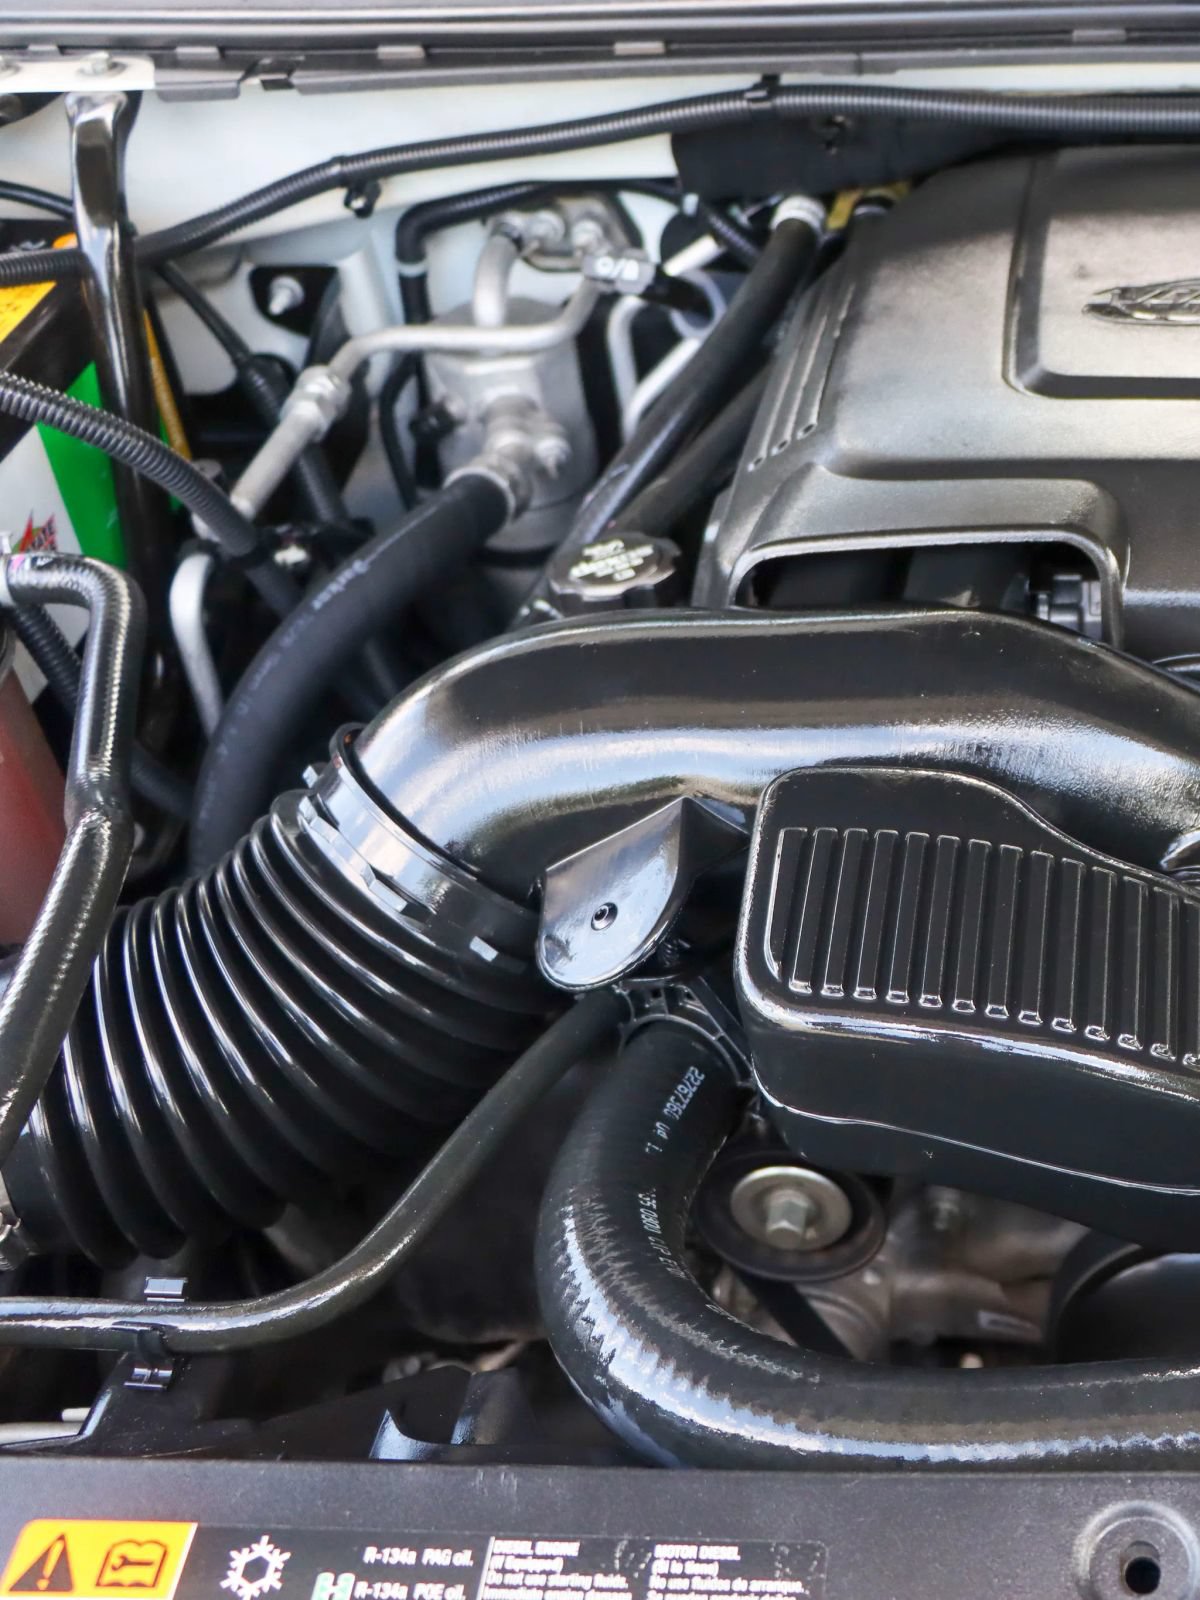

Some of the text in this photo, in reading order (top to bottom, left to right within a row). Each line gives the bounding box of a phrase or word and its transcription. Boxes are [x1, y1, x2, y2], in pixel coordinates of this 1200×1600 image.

[663, 1065, 706, 1120] 22767360
[363, 1546, 417, 1565] R-134a
[421, 1548, 452, 1566] PAG
[486, 1570, 503, 1585] Do
[354, 1581, 408, 1600] R-134a
